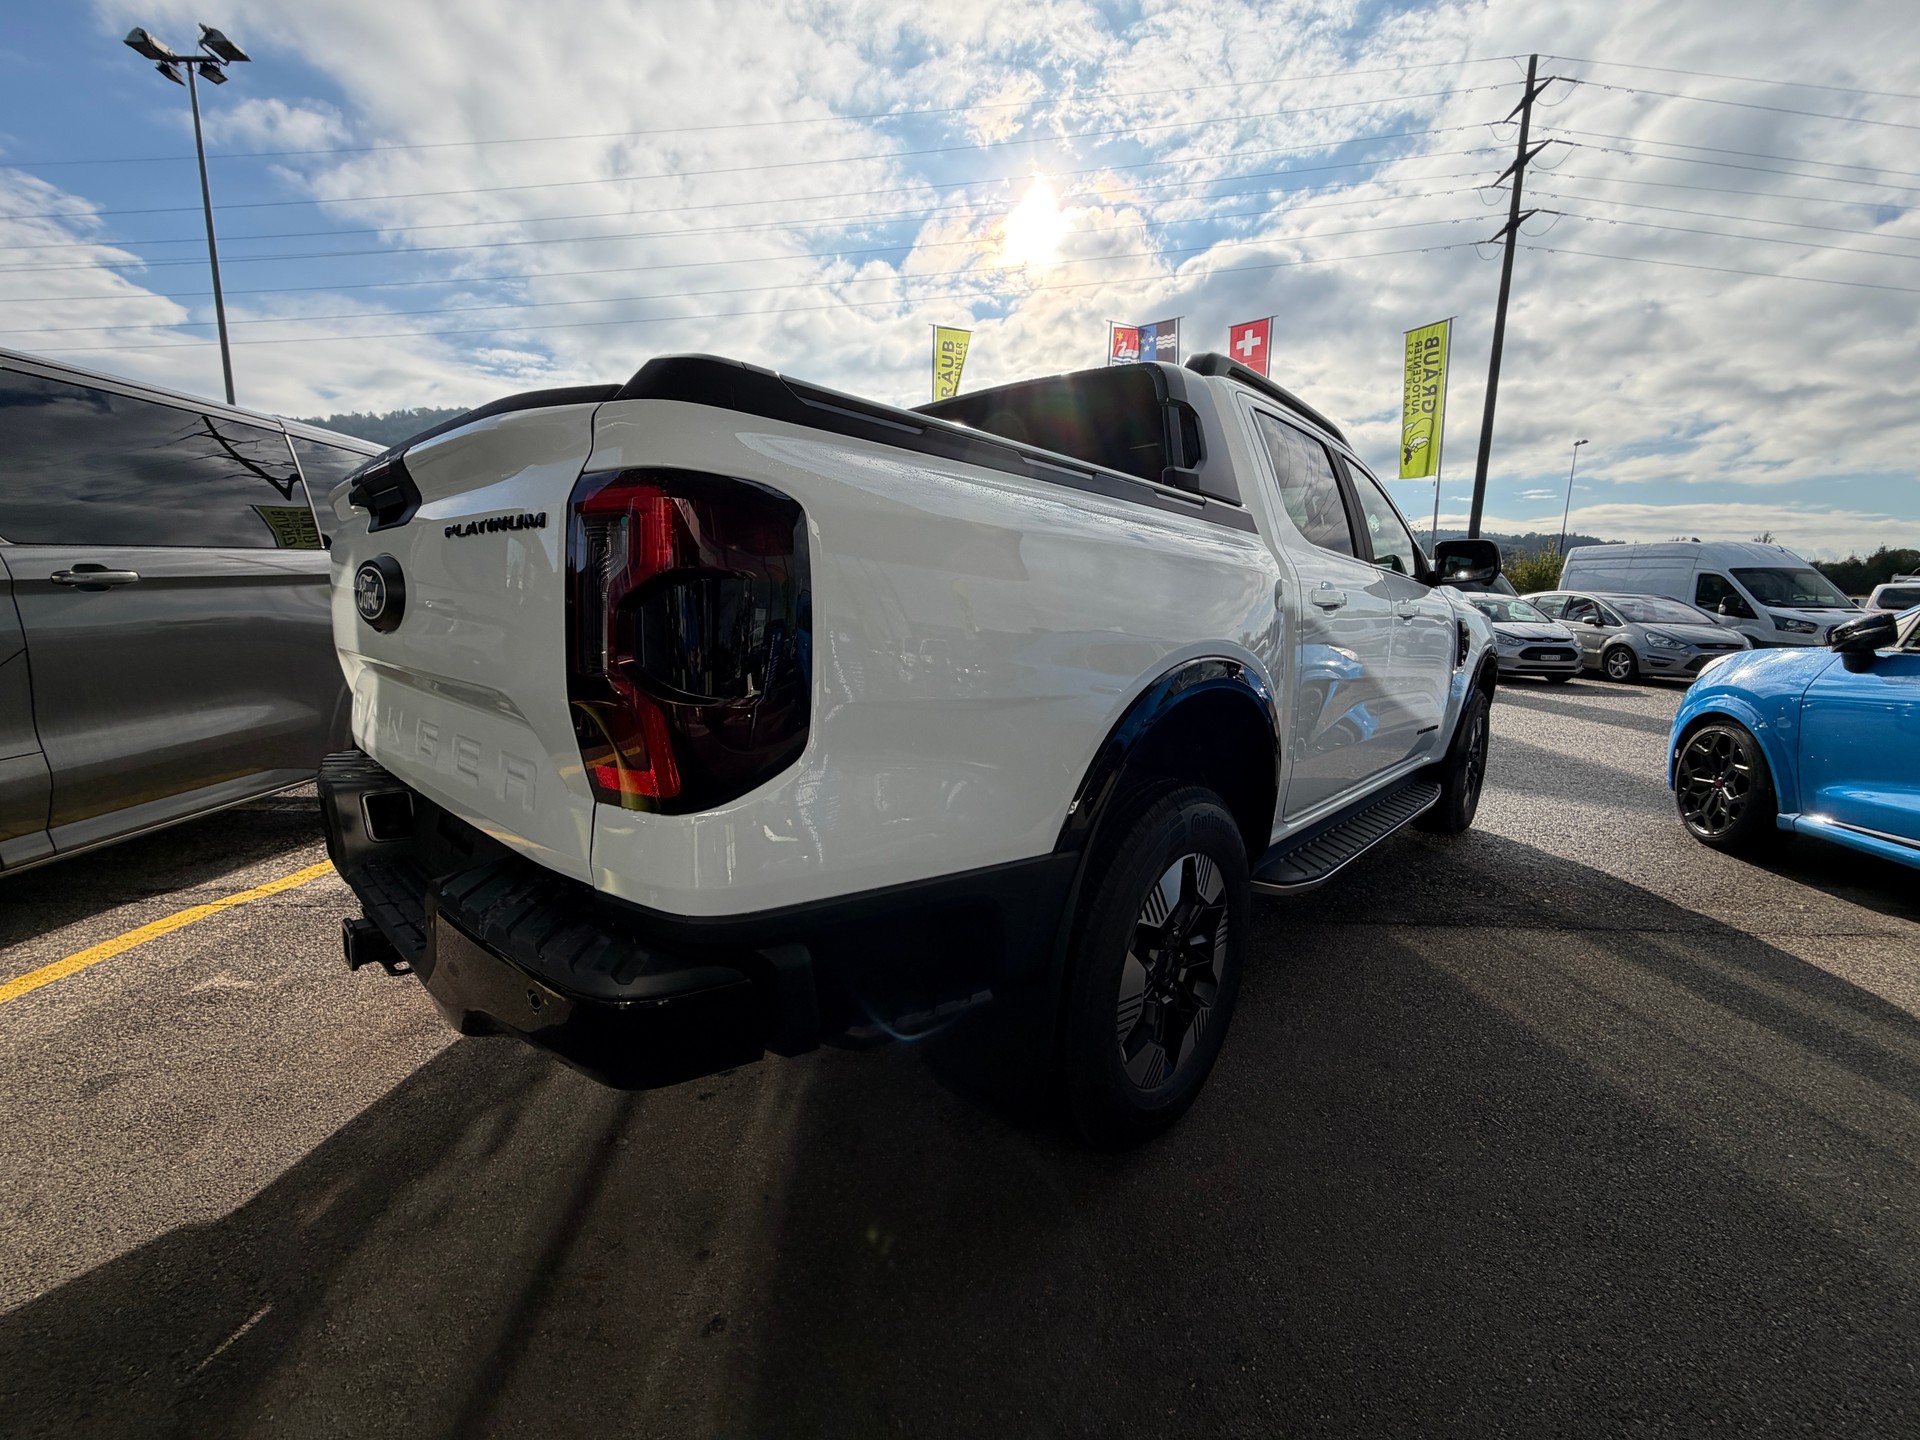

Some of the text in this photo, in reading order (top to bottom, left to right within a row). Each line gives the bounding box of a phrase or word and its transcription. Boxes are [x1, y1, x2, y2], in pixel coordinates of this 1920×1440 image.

[937, 340, 955, 398] RÄUB
[954, 342, 963, 382] ENTER
[444, 511, 546, 538] PLATINUM
[357, 574, 379, 610] Ford
[354, 689, 538, 812] RANGER
